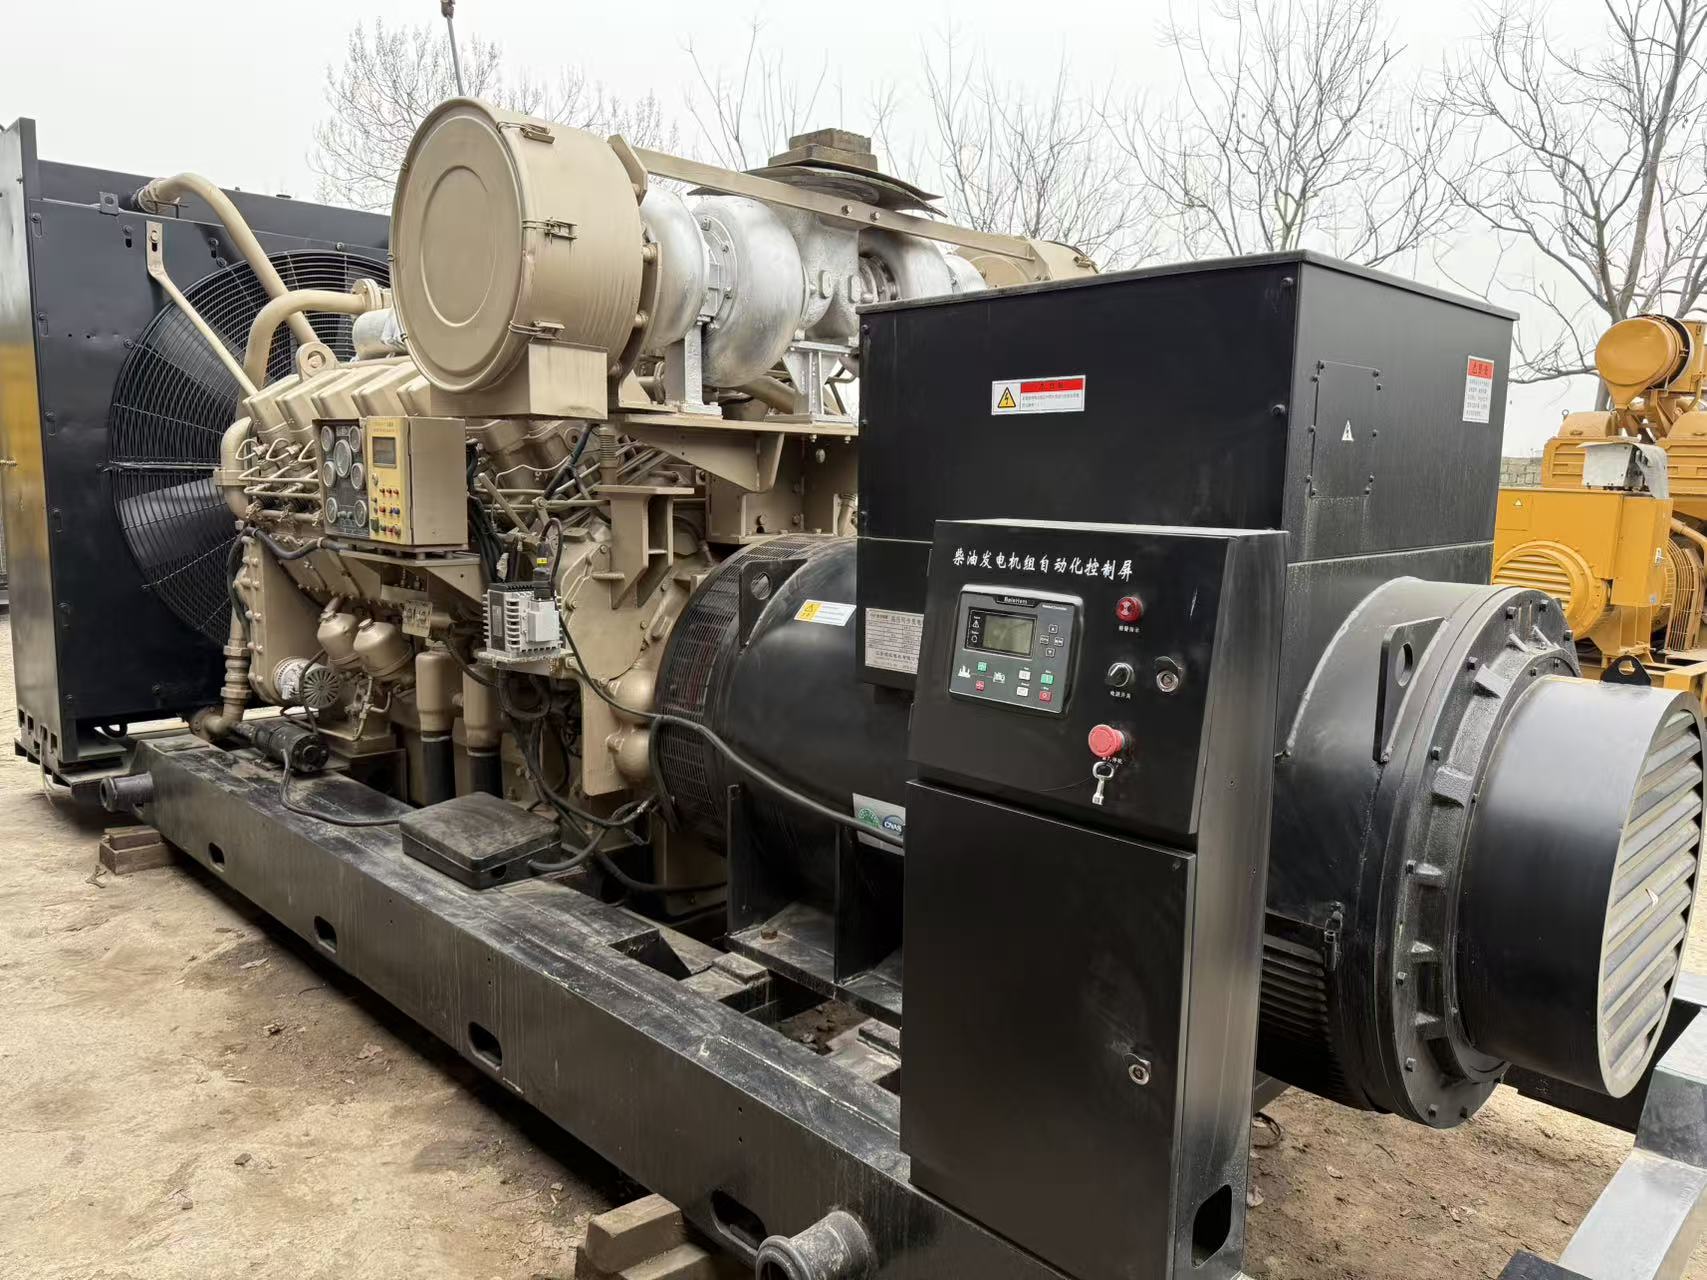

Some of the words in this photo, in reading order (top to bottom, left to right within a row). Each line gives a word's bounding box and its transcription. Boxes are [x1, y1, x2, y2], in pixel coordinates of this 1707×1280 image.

[952, 548, 1133, 582] 柴油发电机组自动化控制屏
